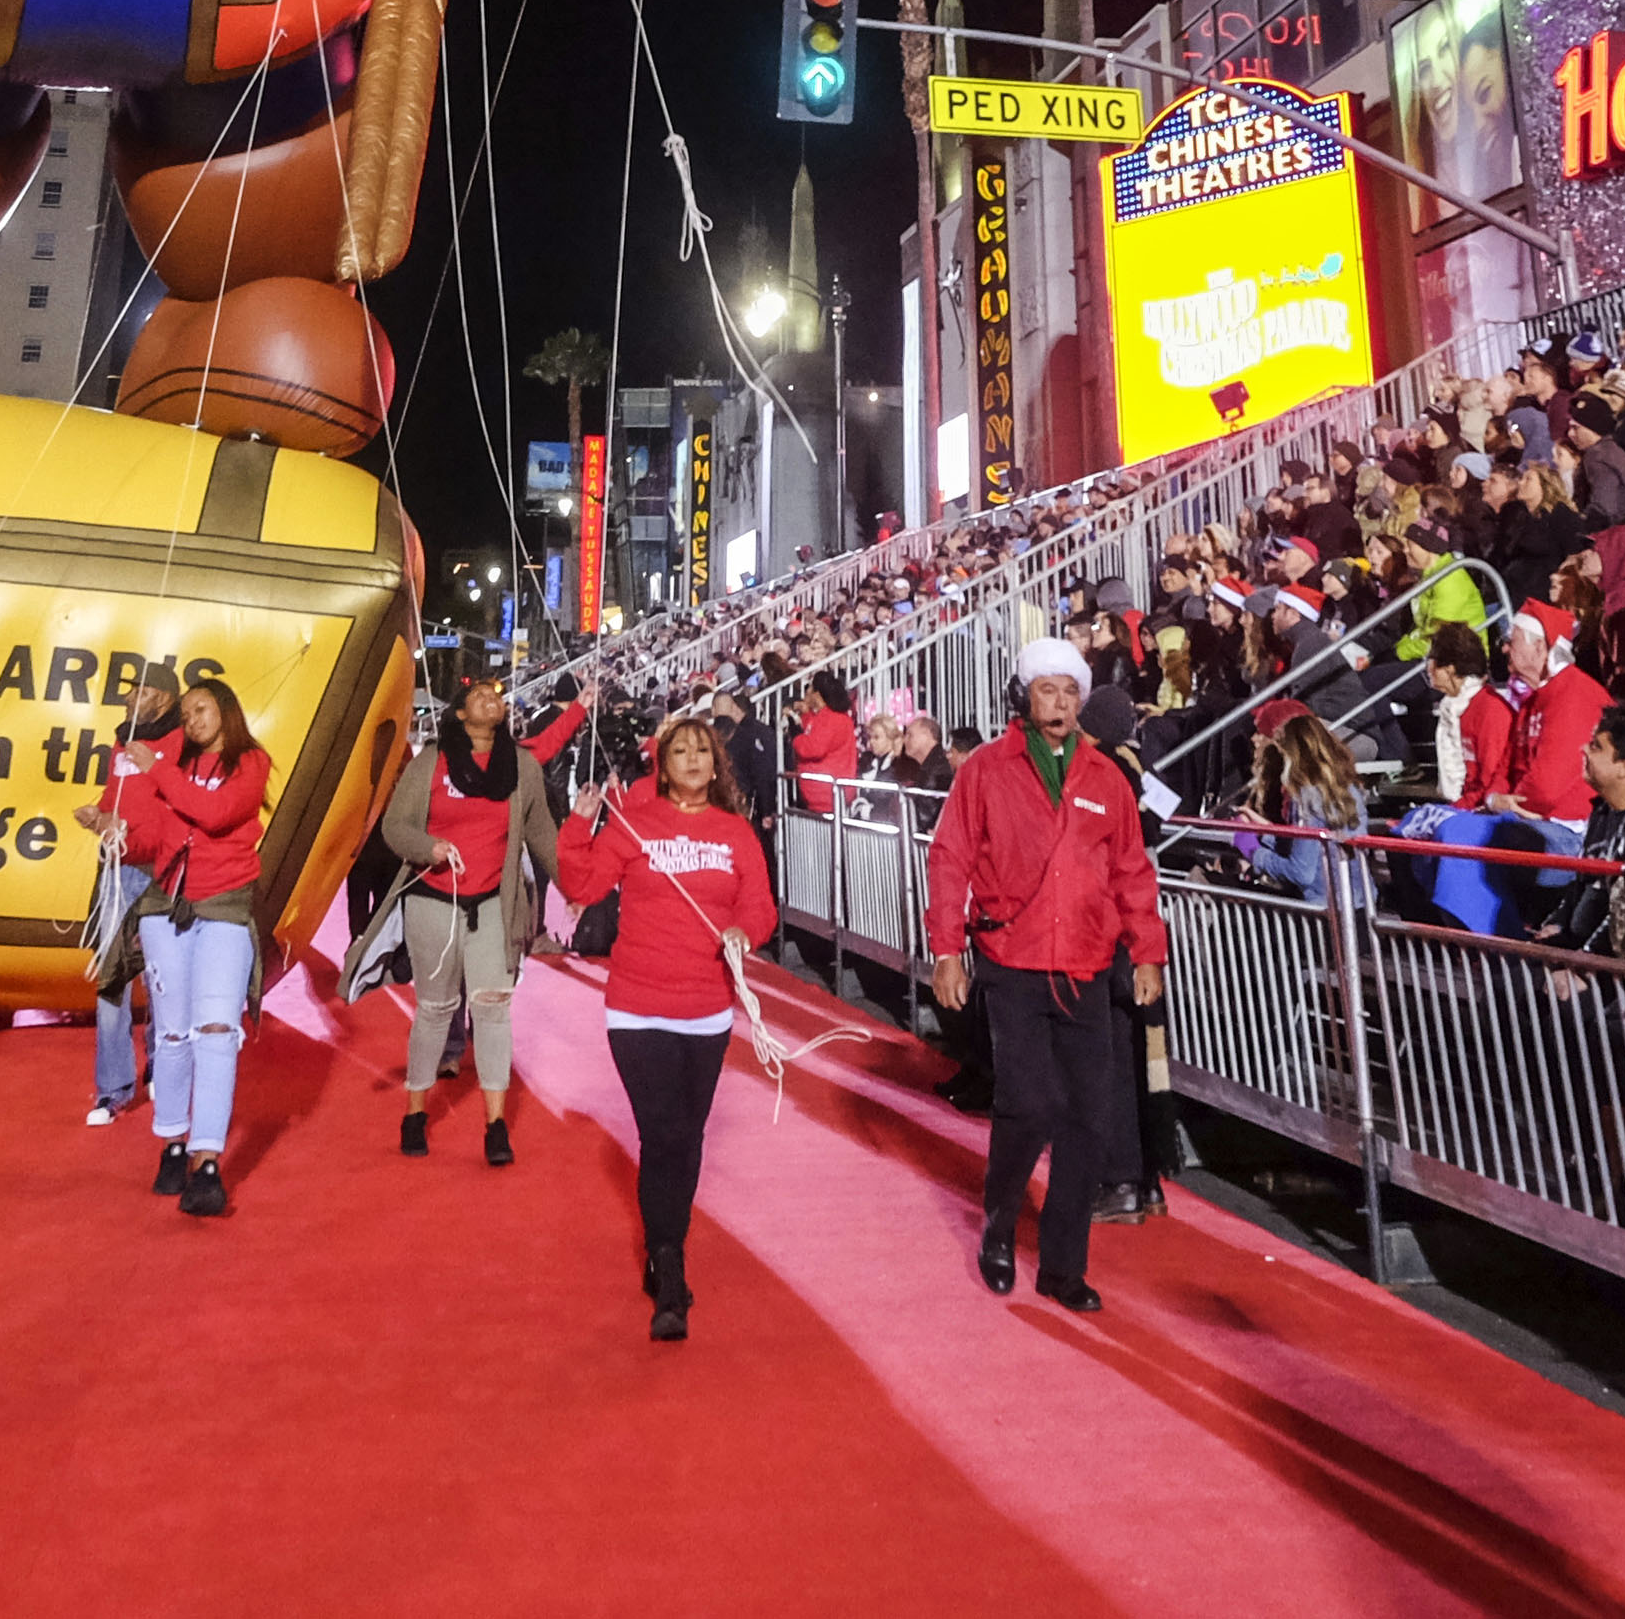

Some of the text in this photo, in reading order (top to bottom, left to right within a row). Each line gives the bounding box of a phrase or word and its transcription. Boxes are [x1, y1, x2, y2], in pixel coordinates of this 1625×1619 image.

[948, 89, 1126, 131] PED XING
[1183, 92, 1250, 128] TCL
[1147, 115, 1295, 172] CHINESE
[1135, 141, 1314, 208] THEATRES
[583, 440, 600, 633] MADAME TUSSAUDS
[42, 726, 116, 786] th
